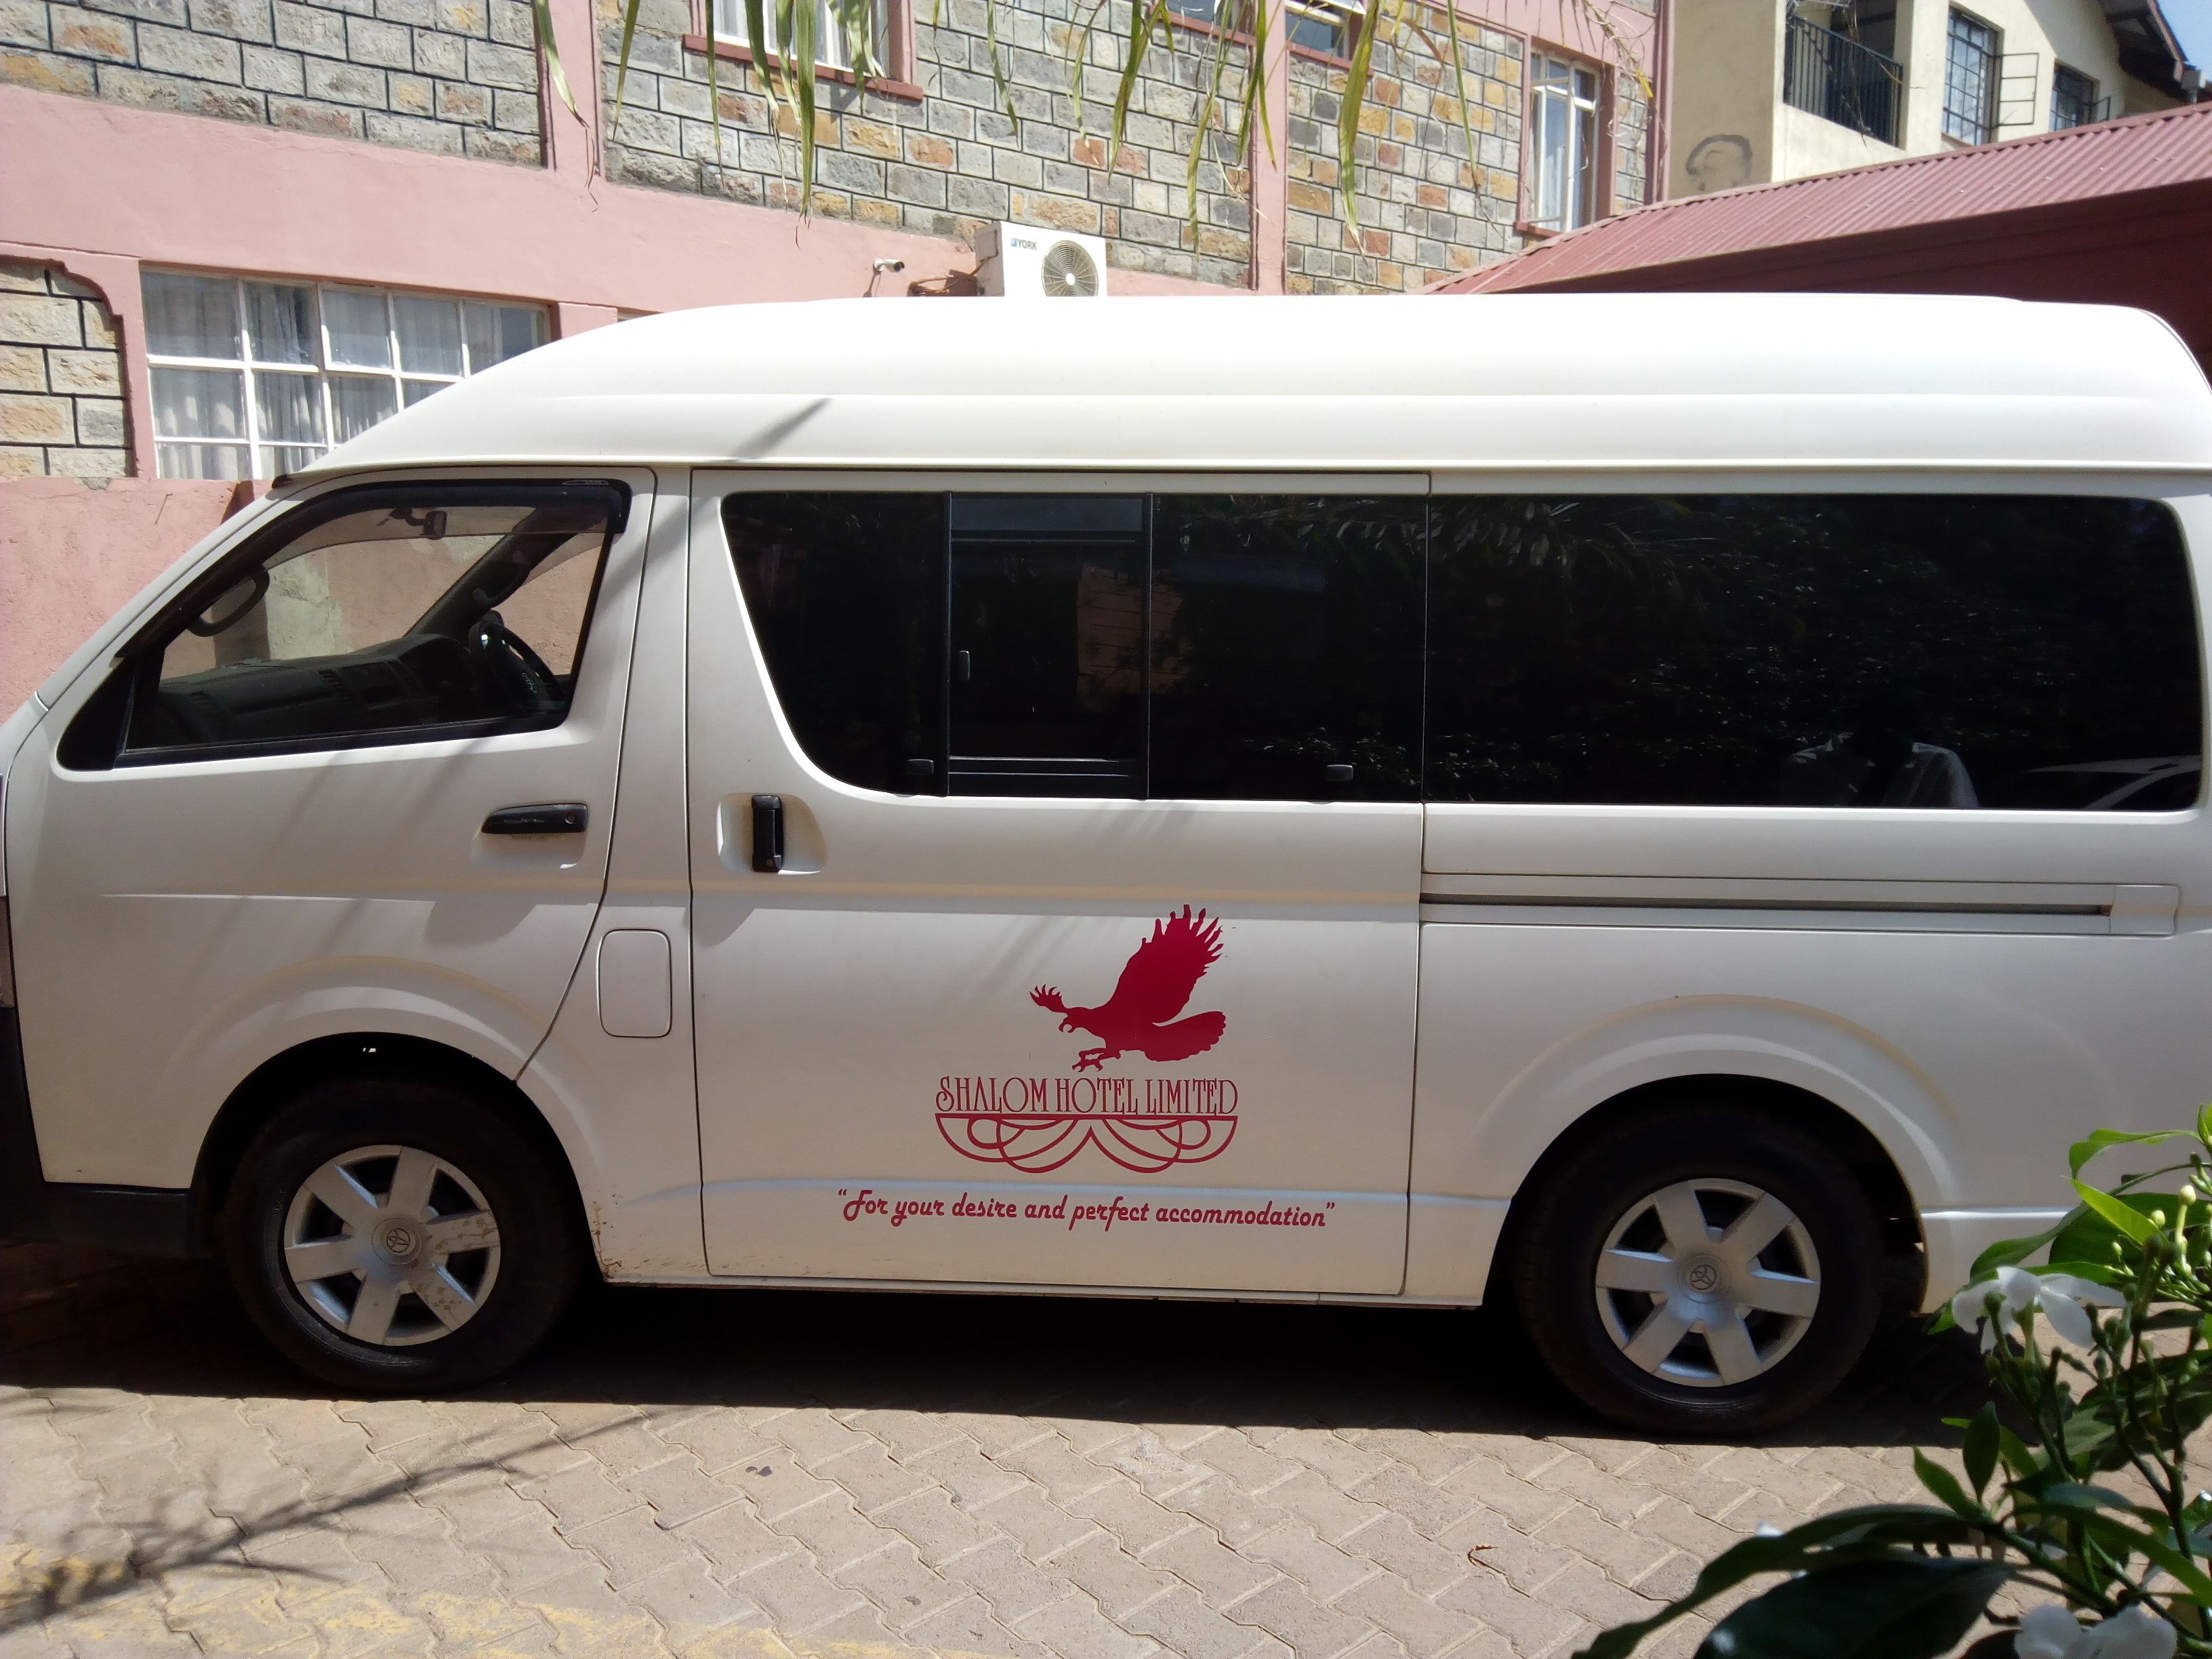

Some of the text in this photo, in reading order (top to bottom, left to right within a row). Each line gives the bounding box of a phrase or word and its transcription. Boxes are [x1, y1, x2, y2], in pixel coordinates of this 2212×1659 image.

[1017, 239, 1037, 250] YORK
[935, 1076, 1238, 1115] SHALOM HOTEL LIMITED
[890, 1199, 945, 1227] your
[951, 1191, 1017, 1218] desire
[1024, 1195, 1069, 1219] and
[1068, 1196, 1149, 1231] perfect
